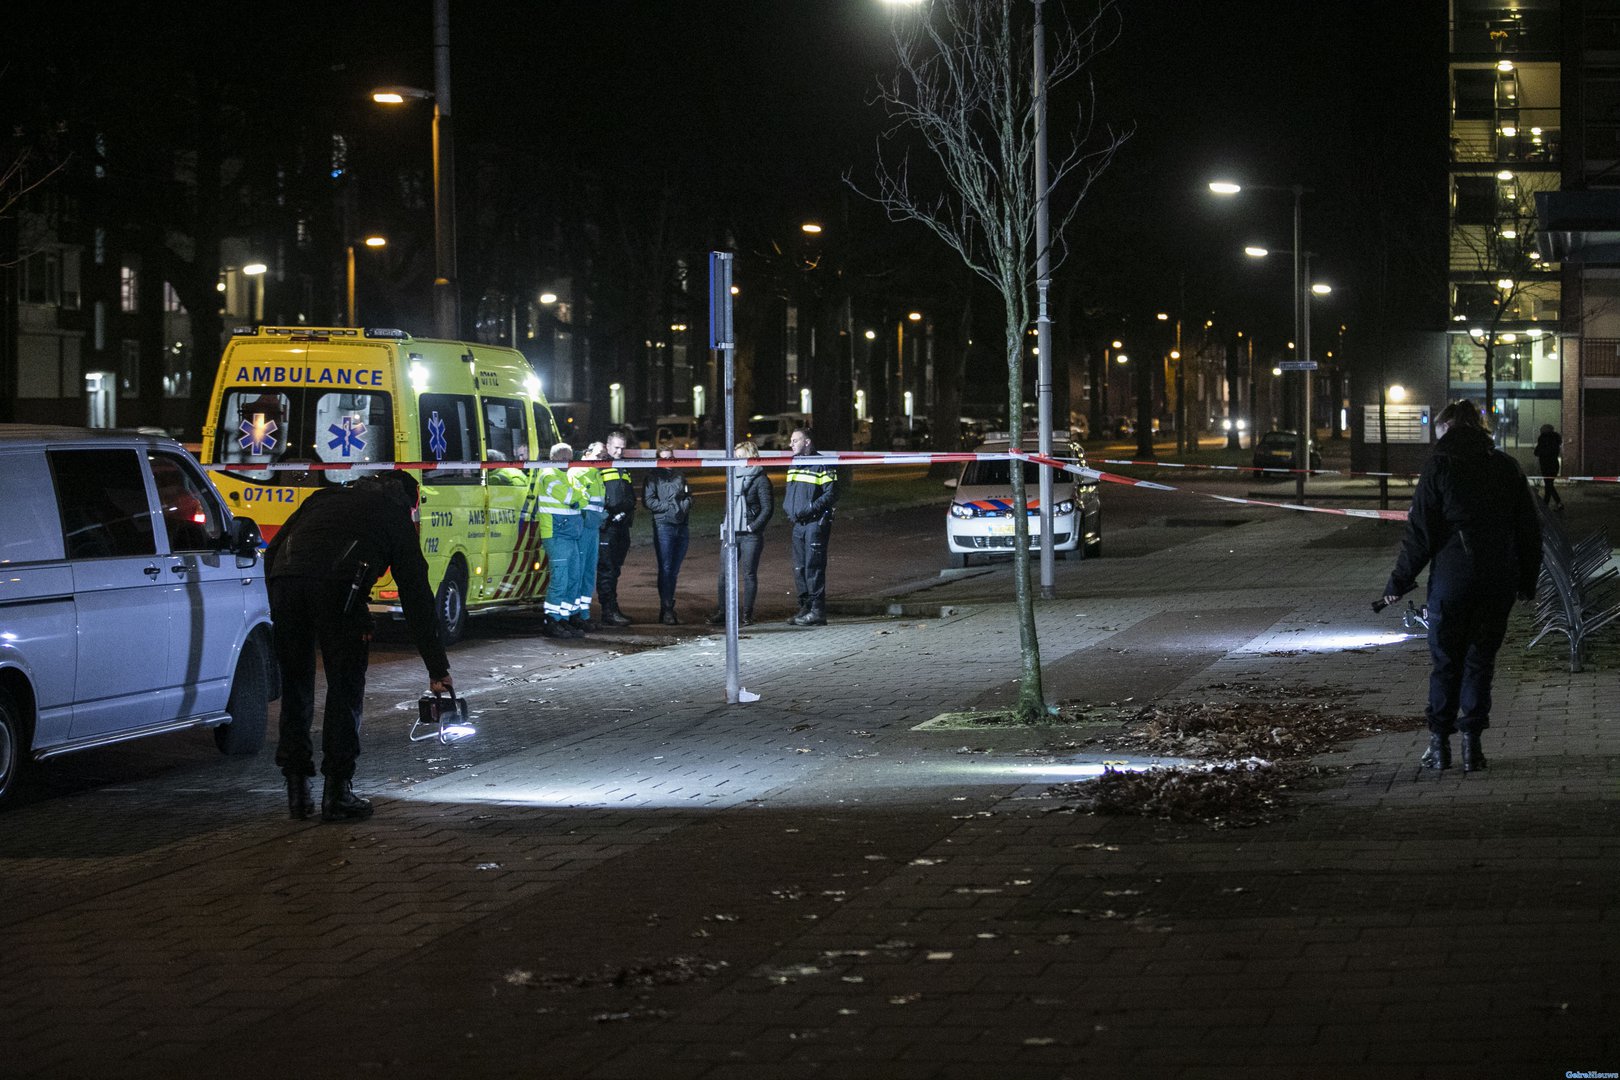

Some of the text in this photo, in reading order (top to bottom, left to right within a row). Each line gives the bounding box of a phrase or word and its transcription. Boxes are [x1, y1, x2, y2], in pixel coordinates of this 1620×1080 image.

[236, 366, 383, 386] AMBULANCE
[243, 487, 294, 503] 07112
[431, 511, 453, 527] 07112
[468, 509, 516, 525] AMBULANCE
